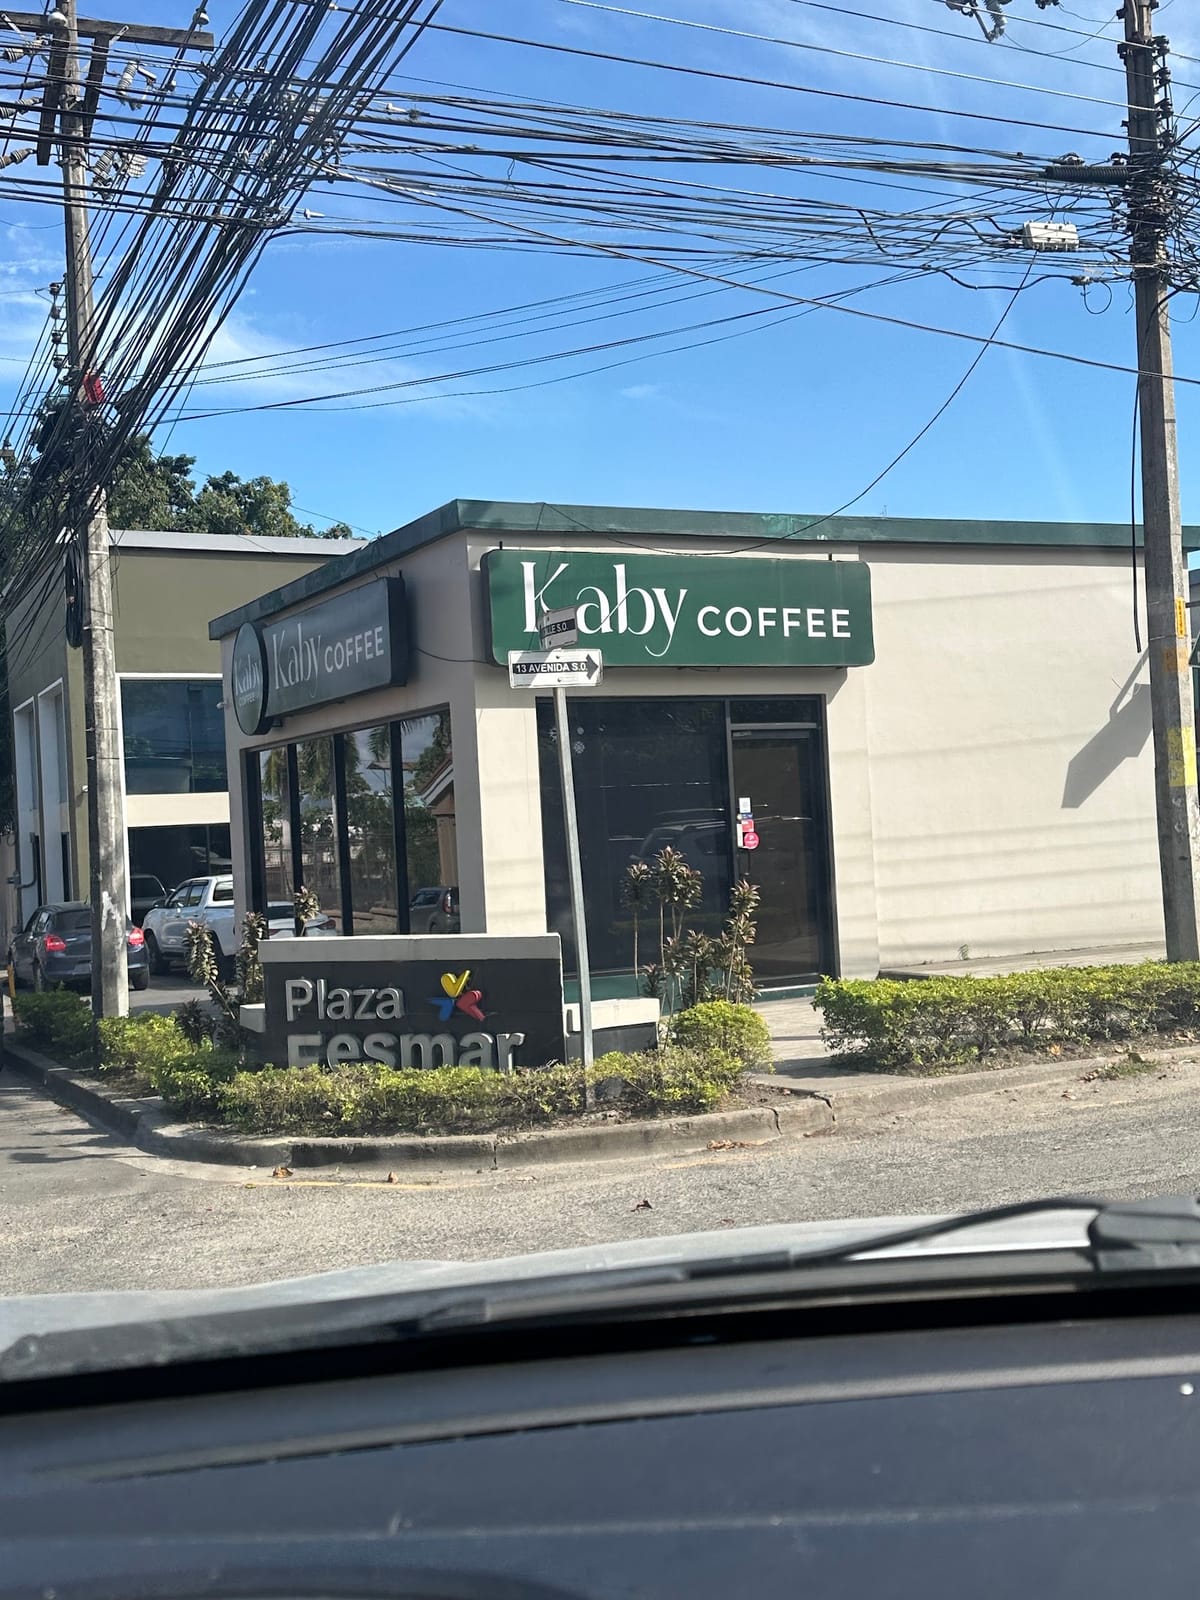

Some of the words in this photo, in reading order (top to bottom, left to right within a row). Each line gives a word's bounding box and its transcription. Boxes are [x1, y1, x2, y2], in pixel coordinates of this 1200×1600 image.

[520, 561, 688, 657] Kaby
[697, 606, 852, 638] COFFEE
[234, 653, 261, 697] Kaby
[272, 623, 321, 698] Kaby
[324, 626, 385, 673] COFFEE
[516, 664, 527, 673] 13
[528, 663, 570, 673] AVENIDA
[571, 662, 588, 672] S.O.
[285, 977, 407, 1022] Plaza
